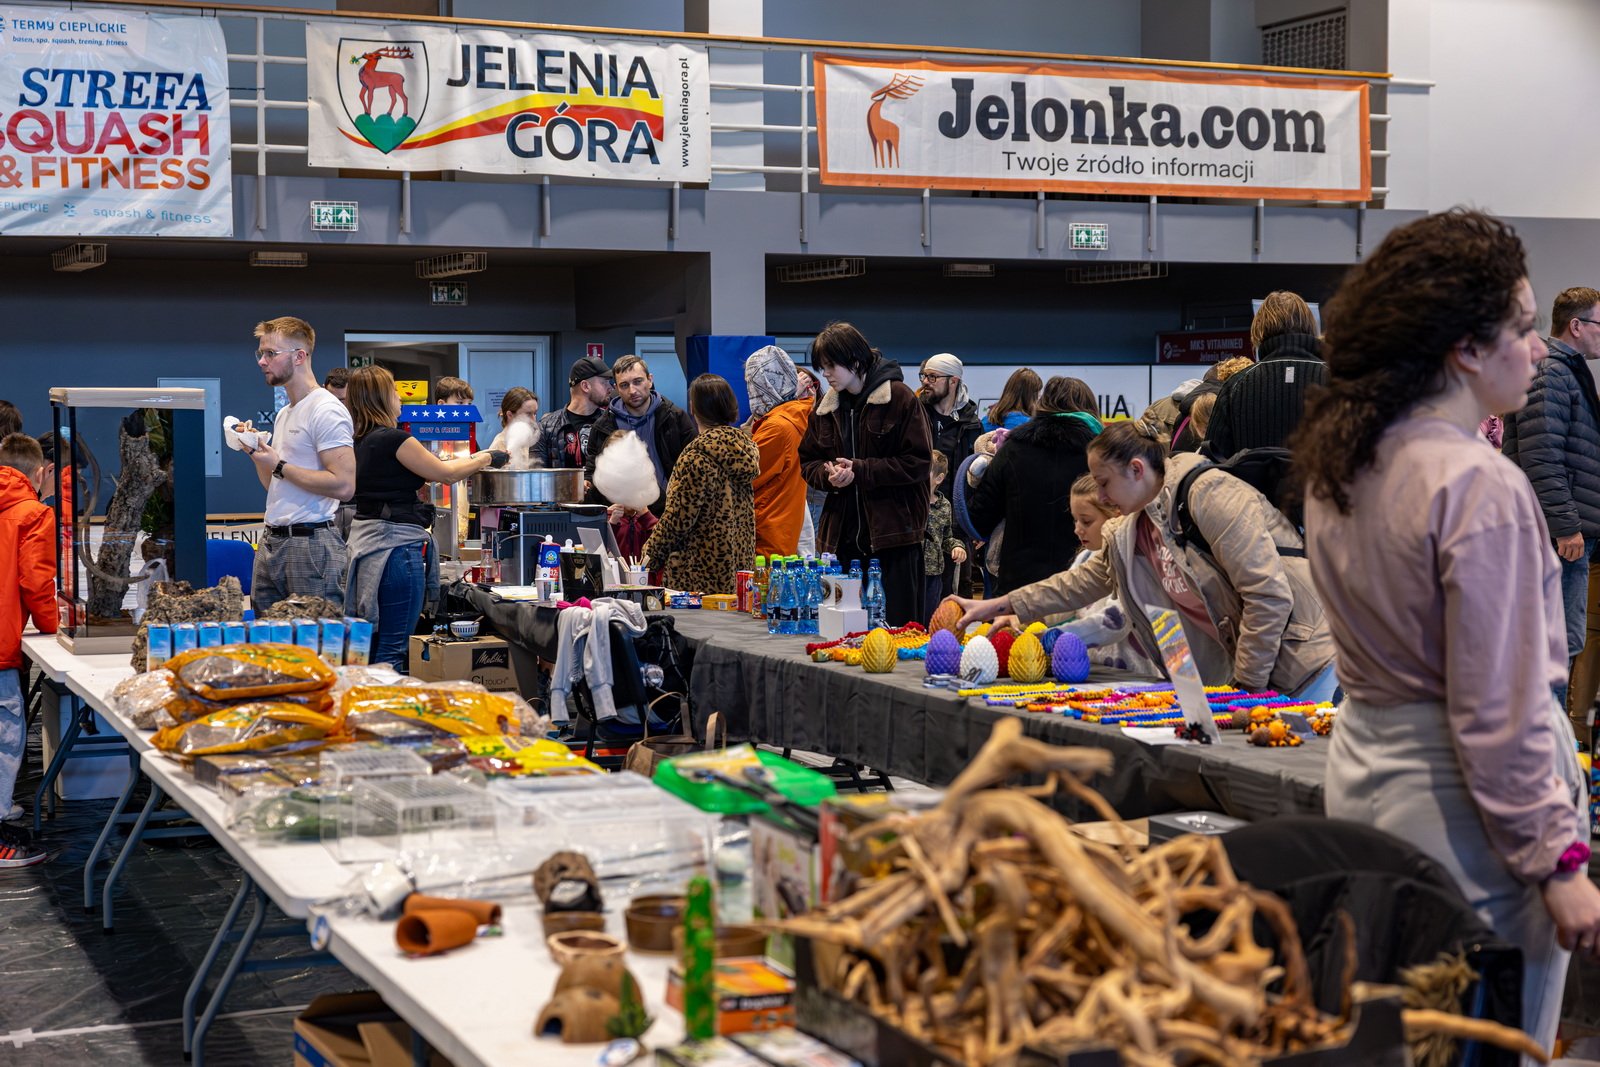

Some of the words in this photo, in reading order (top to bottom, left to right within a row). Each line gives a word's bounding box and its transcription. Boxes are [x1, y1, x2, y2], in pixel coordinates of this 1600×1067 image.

[12, 20, 54, 31] TERMY
[59, 21, 127, 34] CIEPLICKIE
[19, 67, 212, 110] STREFA
[446, 44, 660, 99] JELENIA
[0, 109, 209, 155] QUASH
[507, 102, 660, 164] GÓRA
[679, 57, 691, 167] www.jeleniagora.pl
[938, 77, 1326, 153] Jelonka.com
[0, 155, 23, 188] &
[31, 156, 210, 190] FITNESS
[1003, 151, 1069, 176] Twoje
[1077, 153, 1145, 175] źródło
[1152, 156, 1254, 182] informacji
[93, 207, 141, 218] squash
[146, 208, 155, 219] &
[161, 211, 212, 223] fitness
